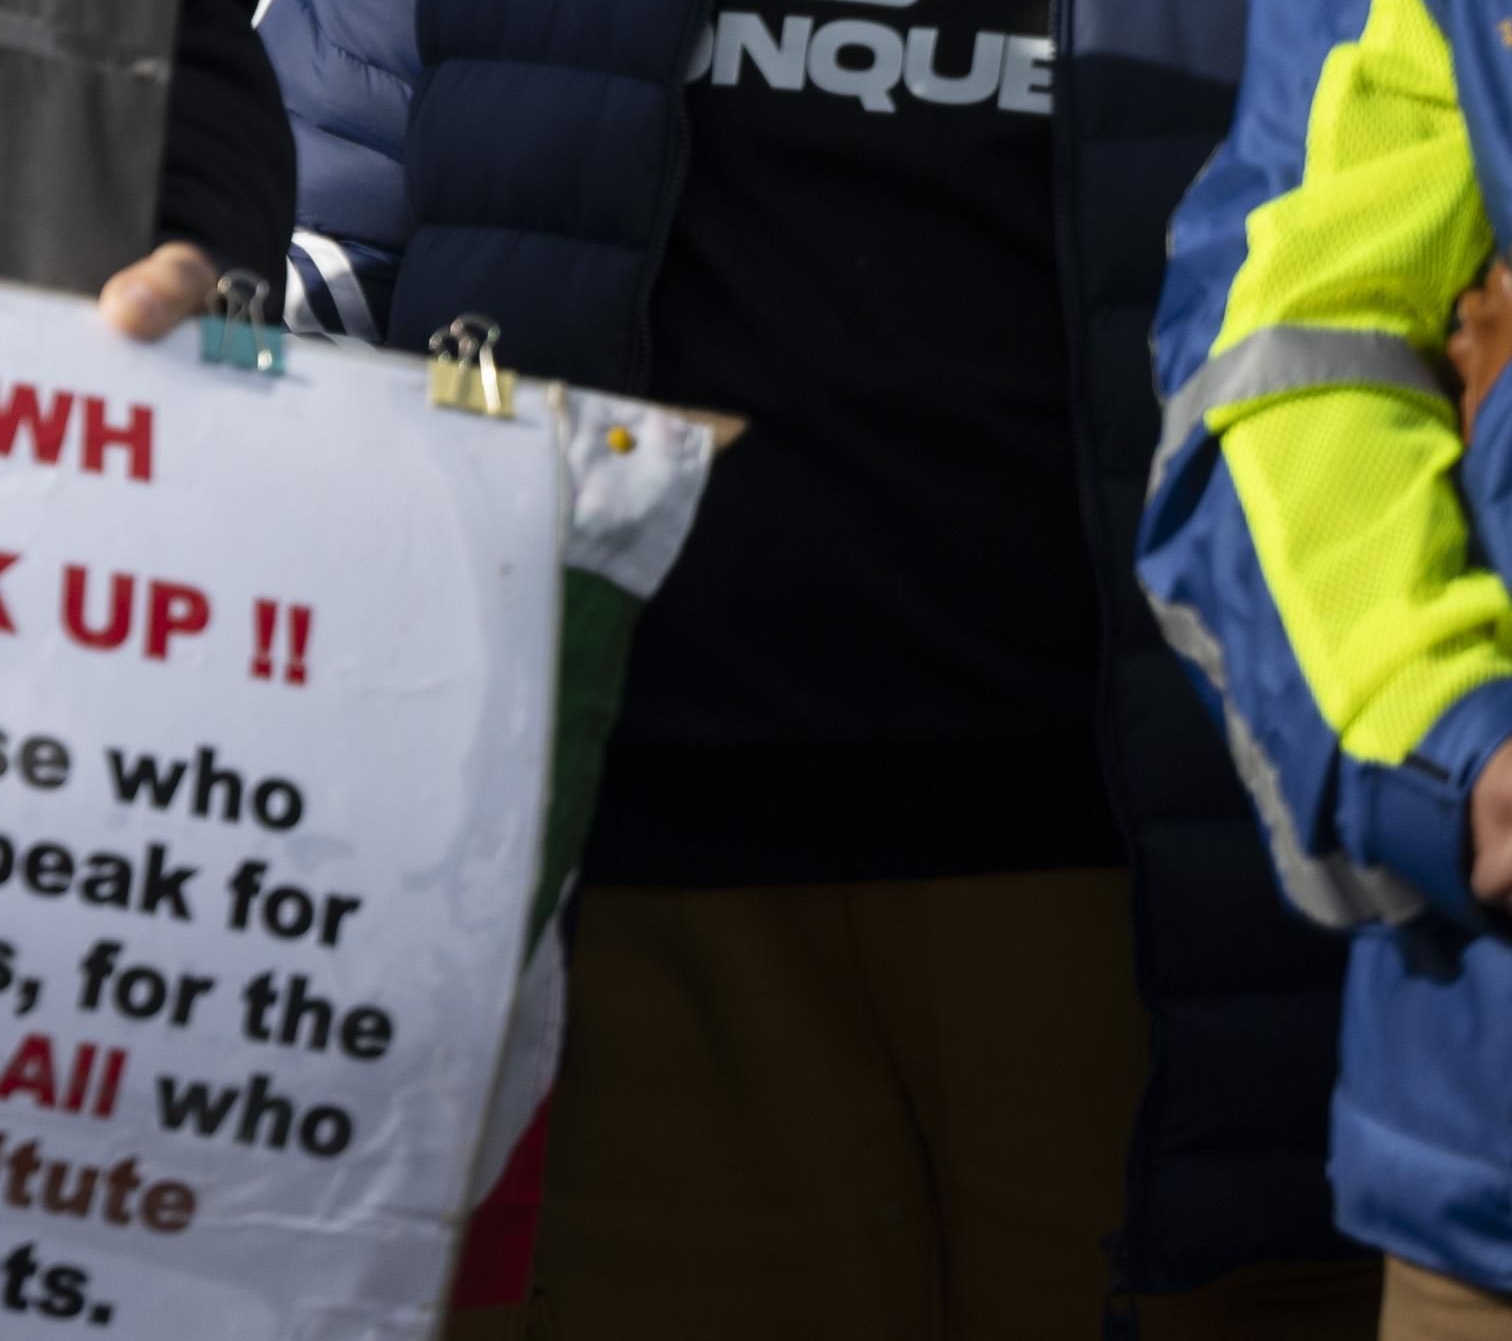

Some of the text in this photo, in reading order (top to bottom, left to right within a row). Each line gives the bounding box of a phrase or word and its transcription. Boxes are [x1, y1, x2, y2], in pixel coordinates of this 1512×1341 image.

[62, 565, 210, 660] UP
[252, 599, 312, 685] !!
[107, 746, 305, 832] who
[228, 859, 362, 949] for
[79, 940, 216, 1028] for
[242, 971, 395, 1063] the
[157, 1073, 356, 1161] who
